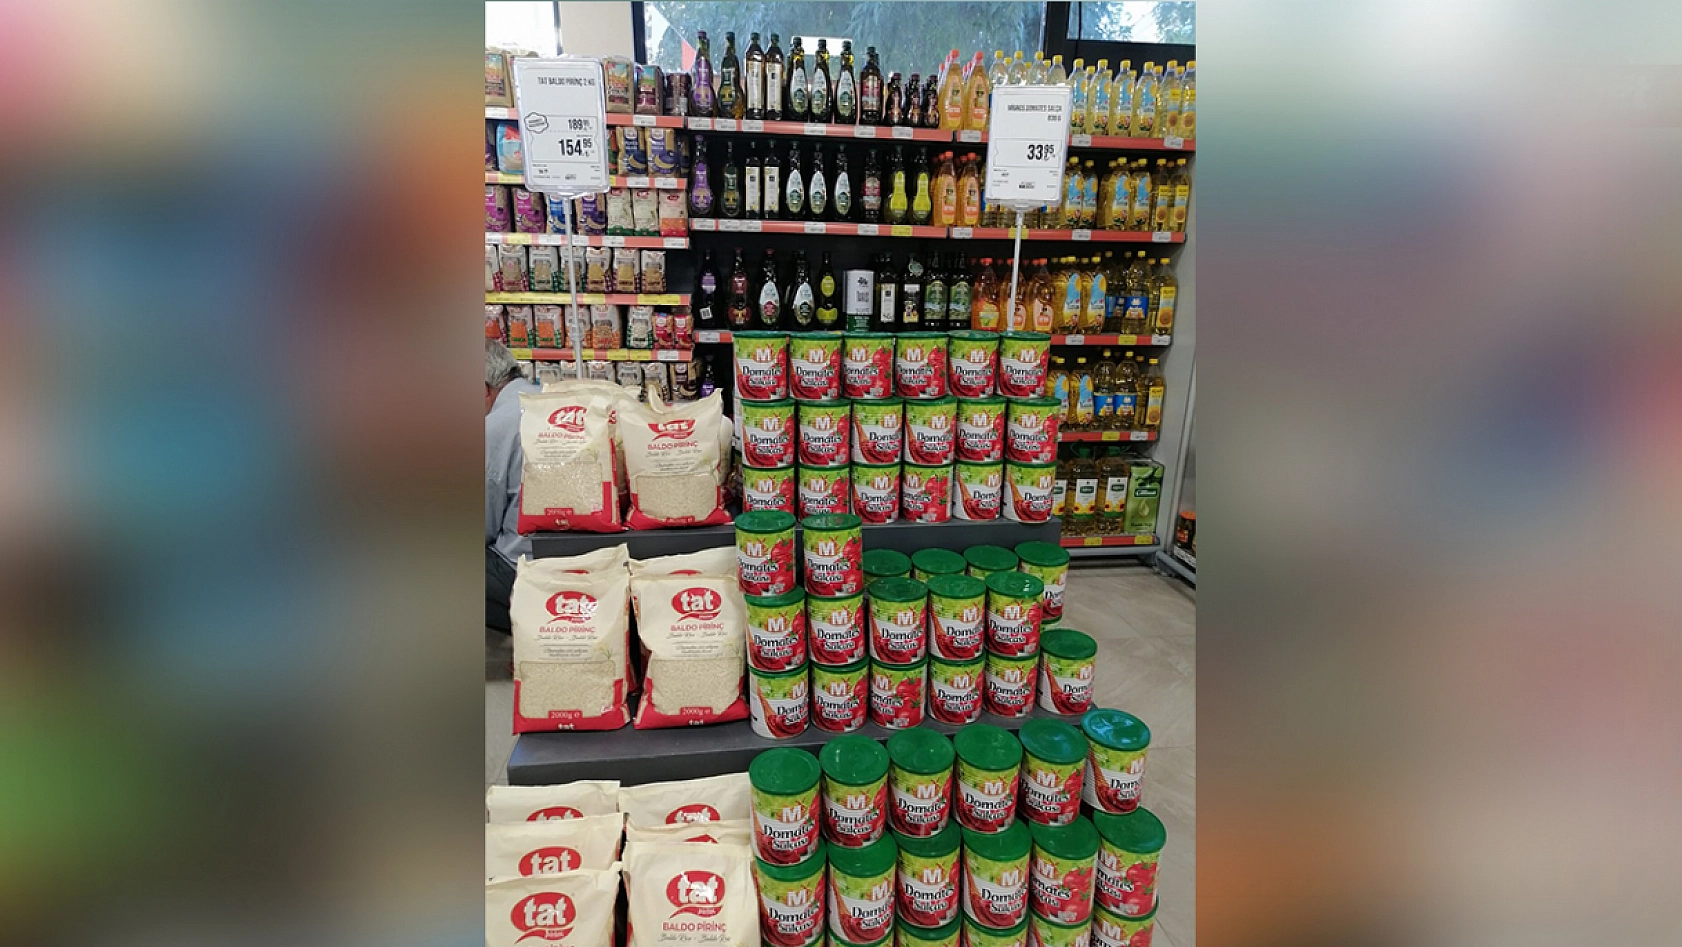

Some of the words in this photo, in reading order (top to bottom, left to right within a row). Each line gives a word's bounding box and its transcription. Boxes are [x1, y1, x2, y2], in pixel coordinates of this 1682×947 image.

[568, 119, 583, 130] 189
[558, 139, 582, 156] 154
[1027, 144, 1044, 161] 33
[756, 348, 771, 361] M
[809, 349, 824, 362] M
[851, 348, 866, 361] M
[906, 348, 921, 361] M
[971, 349, 985, 362] M
[1021, 349, 1035, 362] M
[763, 417, 778, 430] M
[815, 417, 830, 429] M
[883, 415, 896, 428] M
[931, 416, 946, 429] M
[973, 413, 987, 426] M
[1022, 414, 1036, 427] M
[758, 480, 772, 492] M
[810, 479, 824, 492] M
[875, 477, 889, 489] M
[906, 475, 918, 488] M
[1039, 476, 1051, 488] M
[747, 542, 762, 556] M
[818, 541, 835, 556] M
[555, 594, 595, 615] tat
[680, 589, 714, 611] tat
[831, 610, 848, 624] M
[897, 610, 914, 624] M
[964, 608, 977, 622] M
[1004, 606, 1021, 620] M
[670, 624, 698, 632] BALDO
[767, 618, 784, 631] M
[1004, 670, 1021, 683] M
[1080, 667, 1091, 680] M
[830, 682, 847, 696] M
[876, 676, 889, 690] M
[953, 675, 969, 689] M
[793, 682, 805, 698] M
[551, 711, 573, 720] 2000g
[682, 708, 703, 716] 2000g
[1130, 758, 1145, 774] M
[1037, 770, 1057, 788] M
[917, 784, 936, 798] M
[984, 782, 1003, 795] M
[847, 795, 866, 809] M
[782, 806, 801, 823] M
[531, 851, 572, 874] tat
[1100, 850, 1117, 871] M
[1037, 858, 1055, 878] M
[923, 868, 941, 883] M
[1002, 870, 1019, 886] M
[677, 874, 718, 904] tat
[872, 882, 888, 899] M
[787, 890, 807, 907] M
[524, 896, 567, 927] tat
[662, 921, 696, 931] BALDO
[697, 920, 727, 933] PİRİNÇ
[1103, 922, 1121, 940] M
